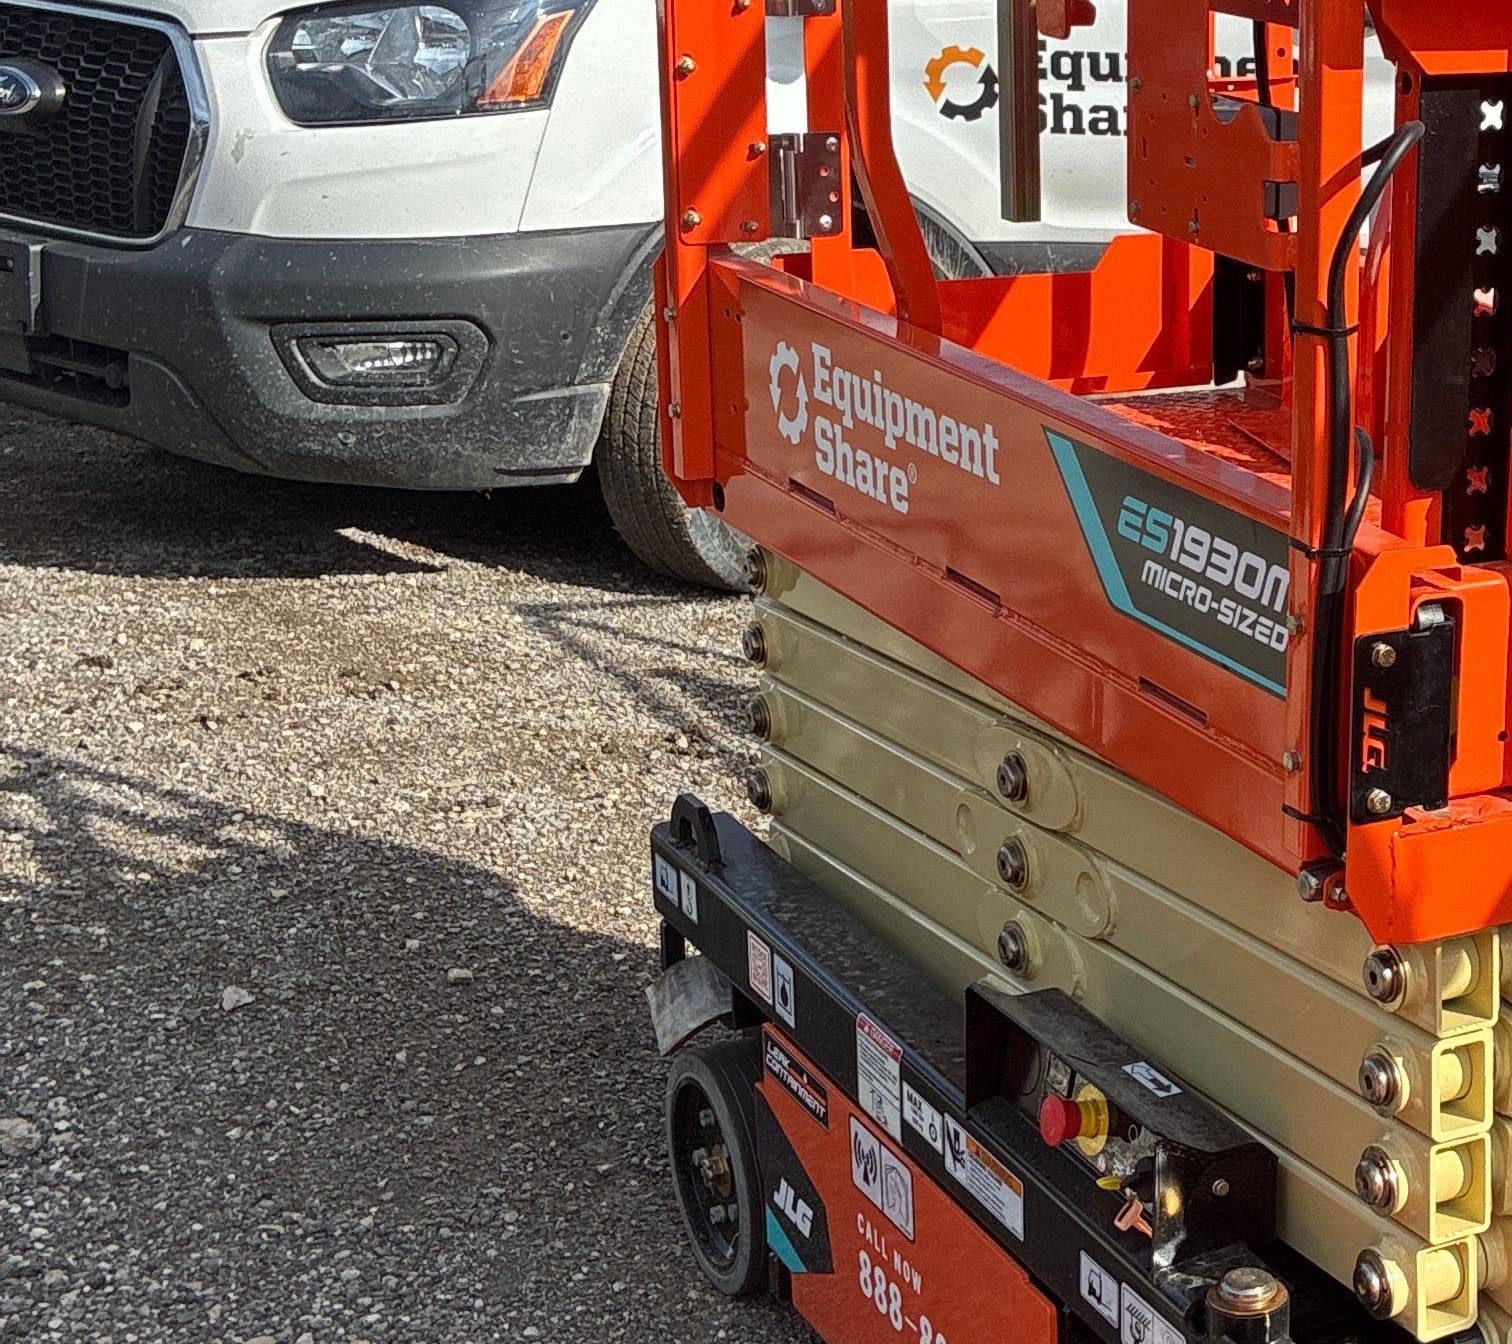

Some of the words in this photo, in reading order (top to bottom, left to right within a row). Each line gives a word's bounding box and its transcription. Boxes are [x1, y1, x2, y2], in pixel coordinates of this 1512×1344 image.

[811, 342, 1000, 485] Equipment
[1141, 559, 1289, 653] MICRO-SIZED
[1362, 686, 1390, 774] JLG
[765, 1052, 827, 1118] CONTAINMENT
[767, 1040, 791, 1070] LEAK
[906, 1088, 923, 1115] MAX
[773, 1176, 814, 1239] JLG
[856, 1212, 888, 1261] CALL
[893, 1249, 922, 1296] NOW
